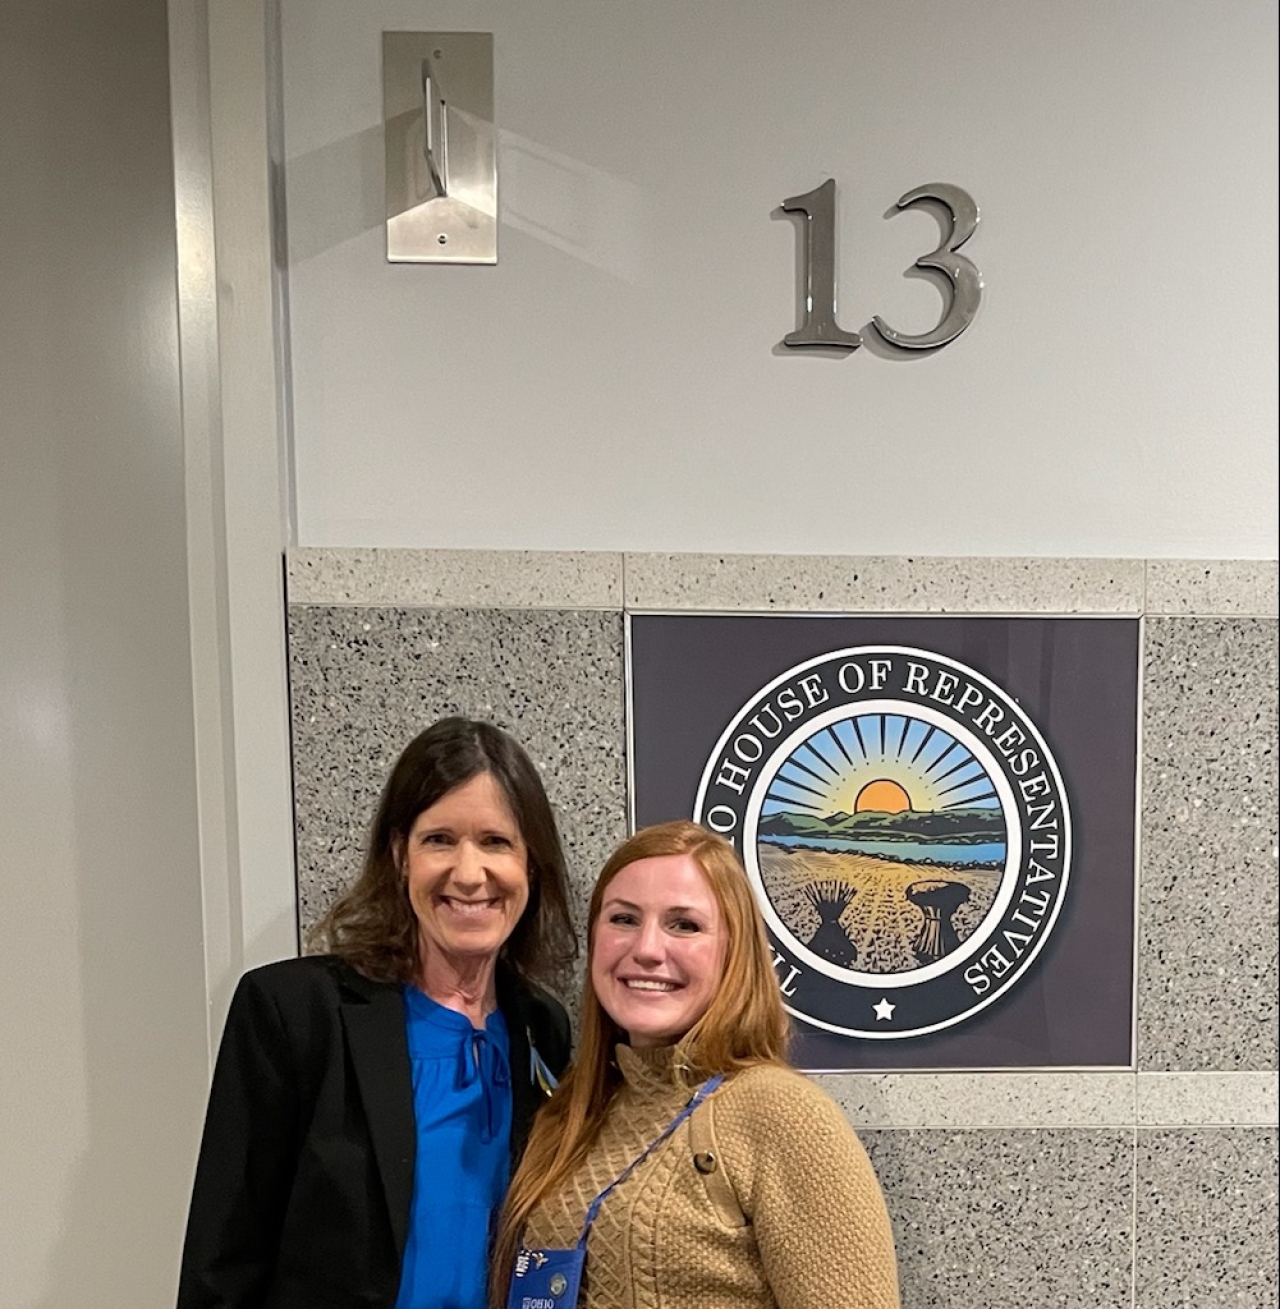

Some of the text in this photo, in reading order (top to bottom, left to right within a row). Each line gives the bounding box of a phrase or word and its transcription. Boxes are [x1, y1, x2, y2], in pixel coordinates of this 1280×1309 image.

[781, 178, 984, 351] 13
[715, 673, 830, 796] HOUSE
[838, 659, 893, 693] OF
[901, 661, 1059, 996] REPRESENTATIVES
